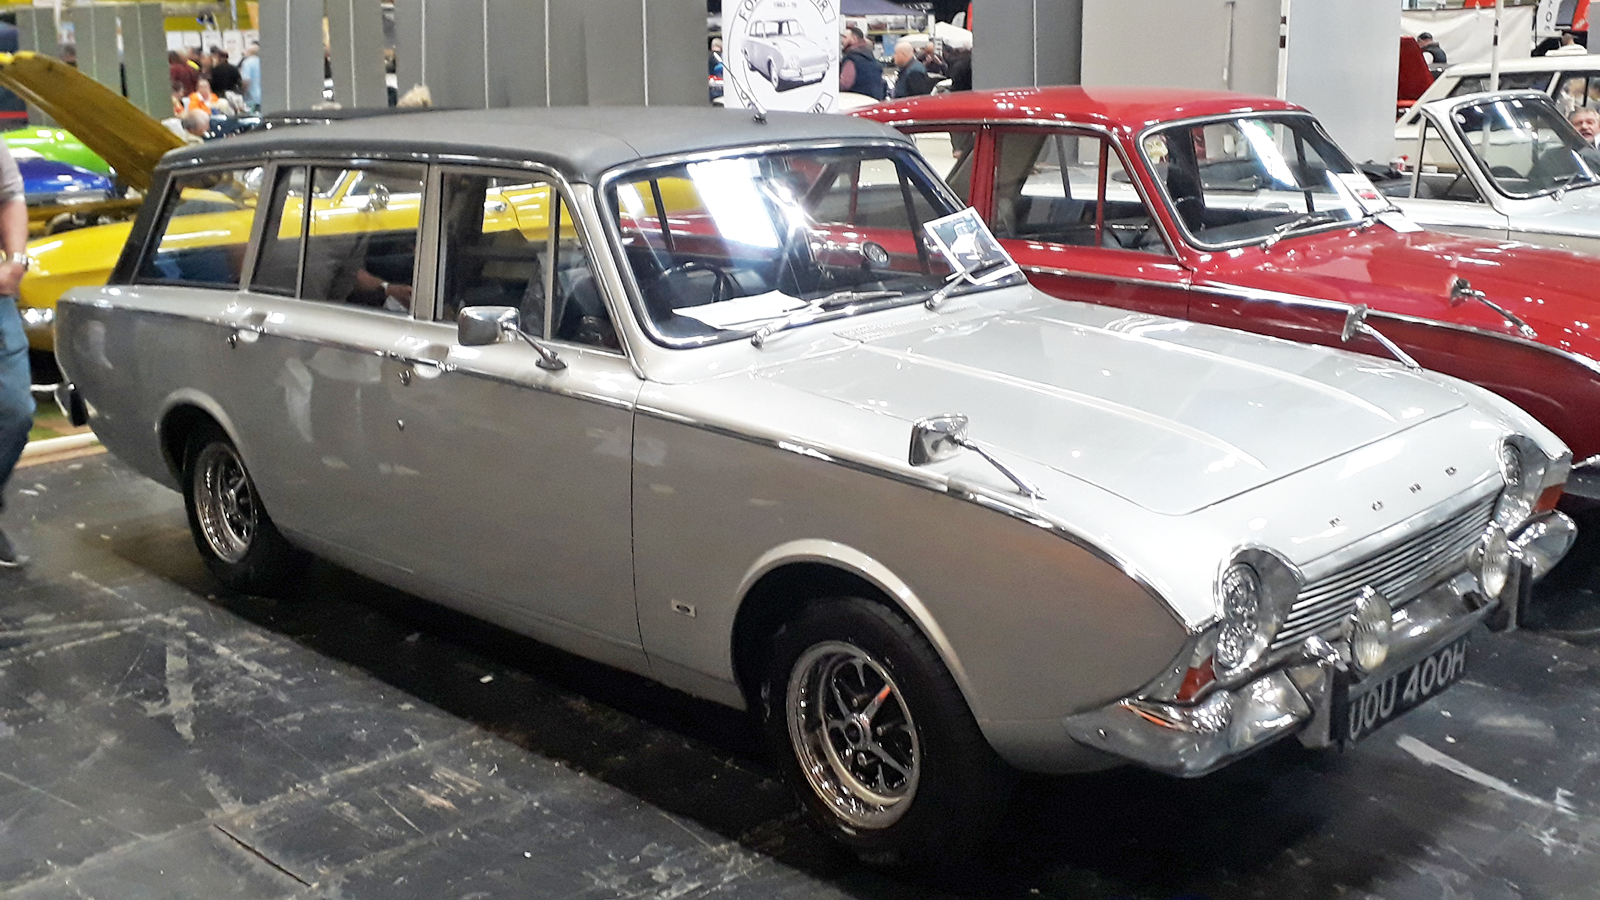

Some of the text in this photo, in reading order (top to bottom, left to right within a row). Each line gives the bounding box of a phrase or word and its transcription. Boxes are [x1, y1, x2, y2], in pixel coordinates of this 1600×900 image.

[1329, 466, 1457, 528] FORD
[1350, 640, 1466, 740] UOU 400H
